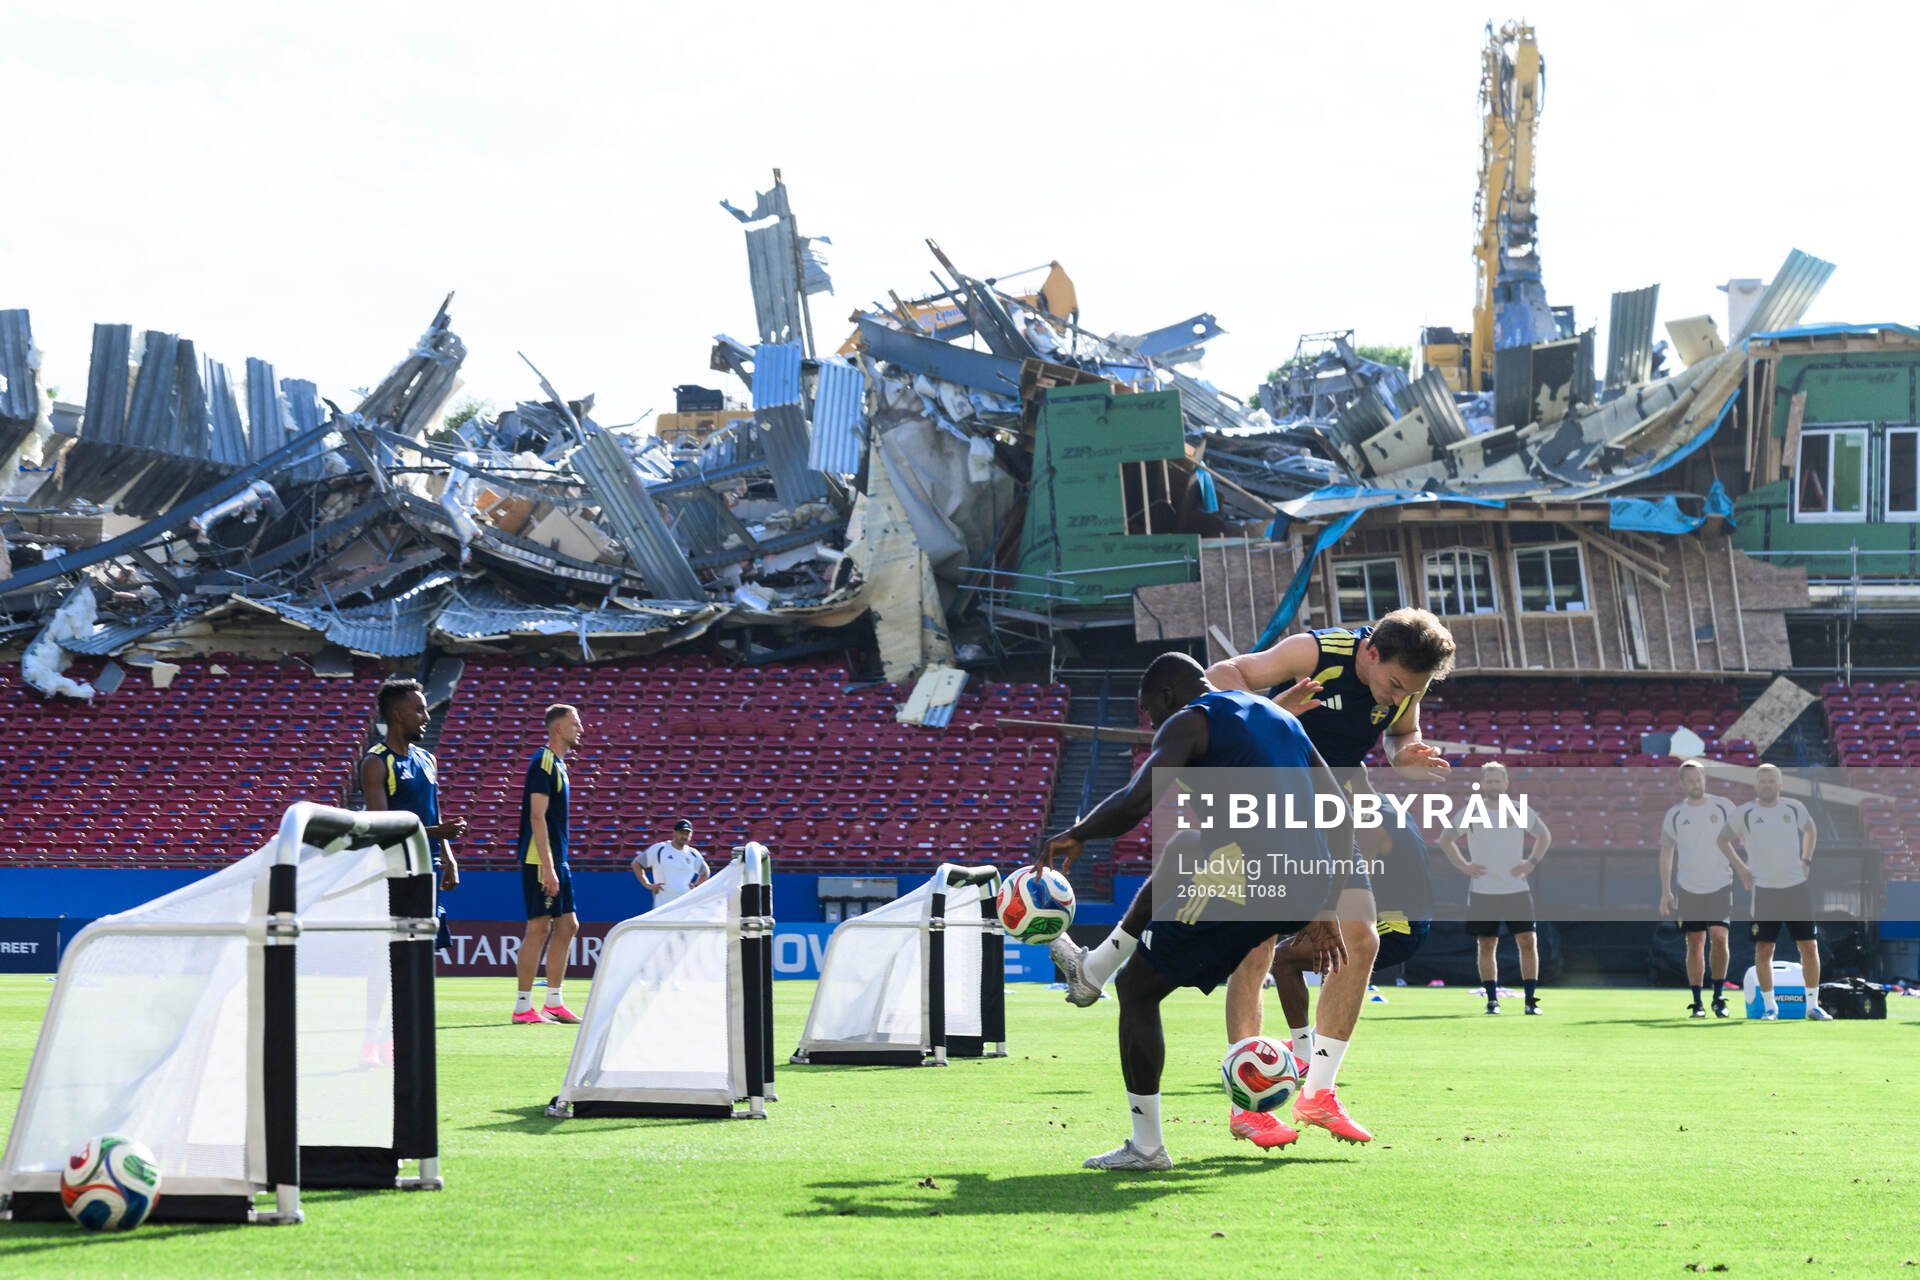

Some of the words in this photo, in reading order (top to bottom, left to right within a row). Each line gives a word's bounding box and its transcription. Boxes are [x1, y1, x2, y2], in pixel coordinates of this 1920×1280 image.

[1066, 515, 1098, 528] ZIP
[1073, 584, 1105, 596] ZIP
[0, 941, 39, 954] REET
